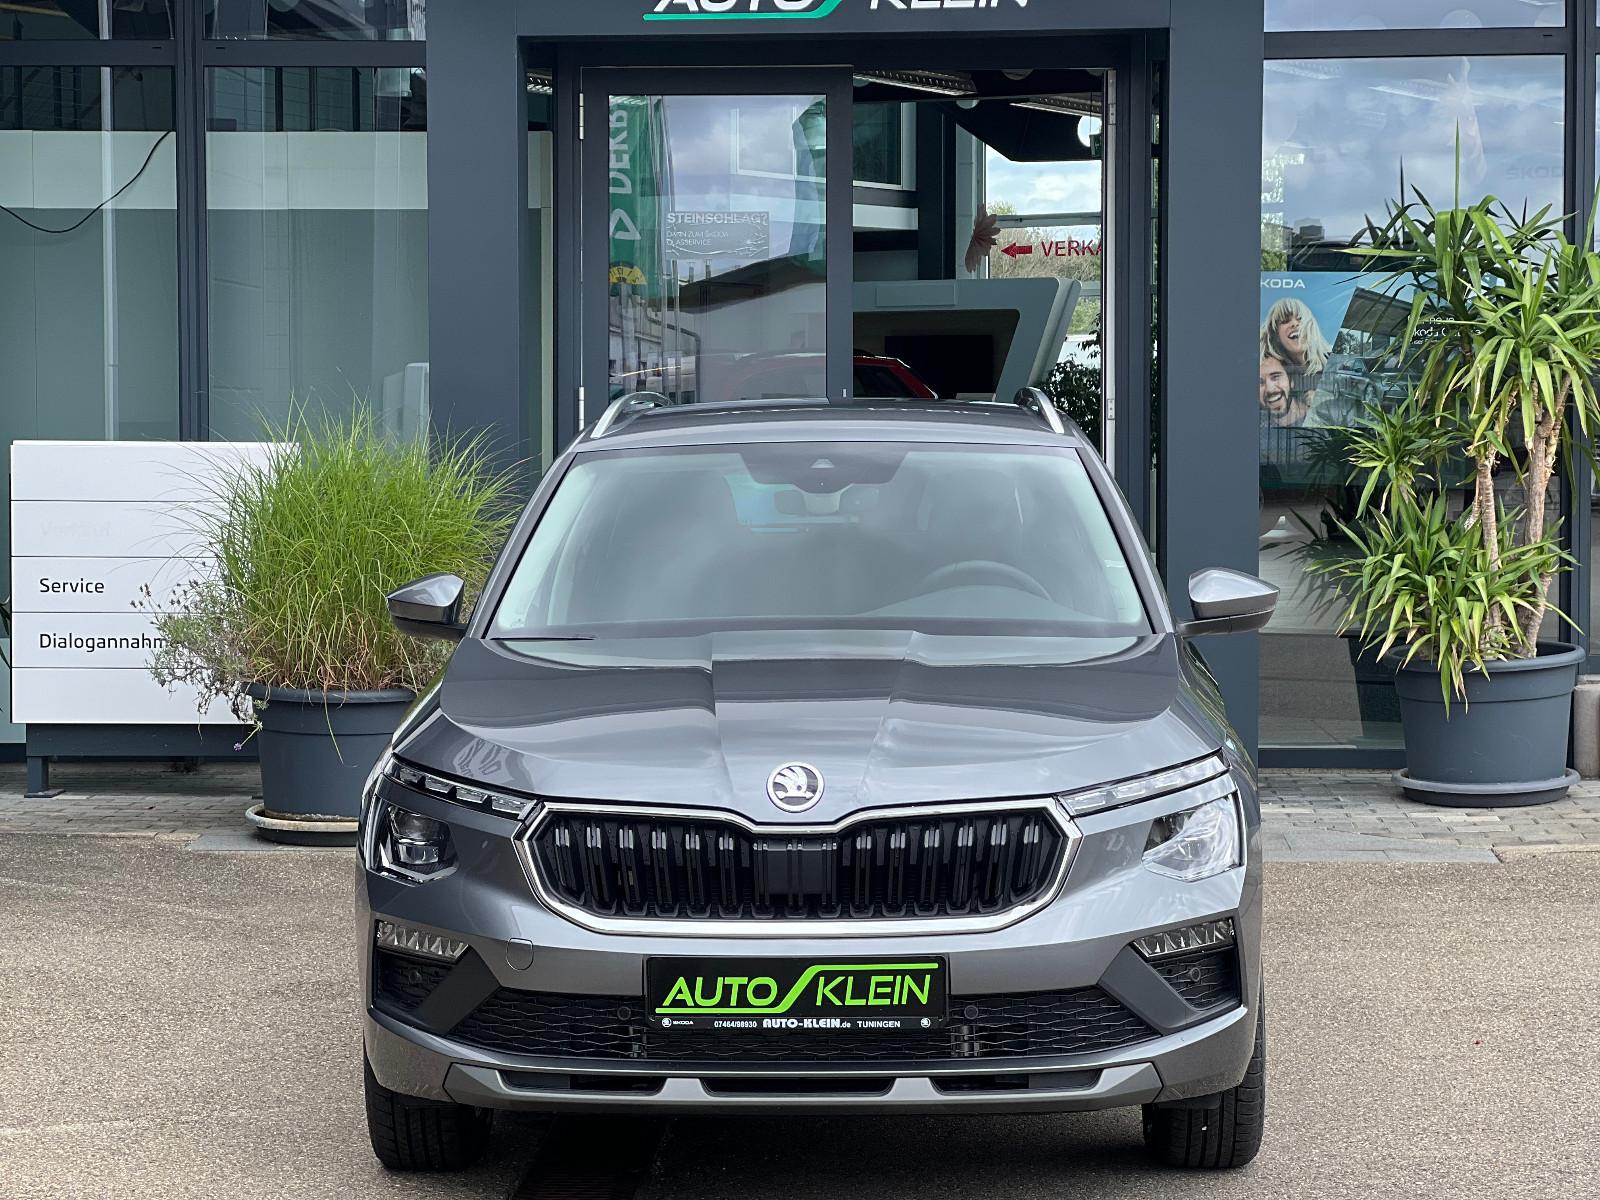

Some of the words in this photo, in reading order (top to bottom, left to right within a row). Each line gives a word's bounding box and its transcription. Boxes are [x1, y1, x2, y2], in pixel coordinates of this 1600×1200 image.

[39, 577, 105, 593] Service
[662, 976, 778, 1007] AUTO
[816, 974, 931, 1006] KLEIN
[714, 1020, 757, 1028] 07464/98930
[762, 1018, 851, 1029] AUTO-KLEIN.de
[856, 1020, 900, 1028] TUNINGEN
